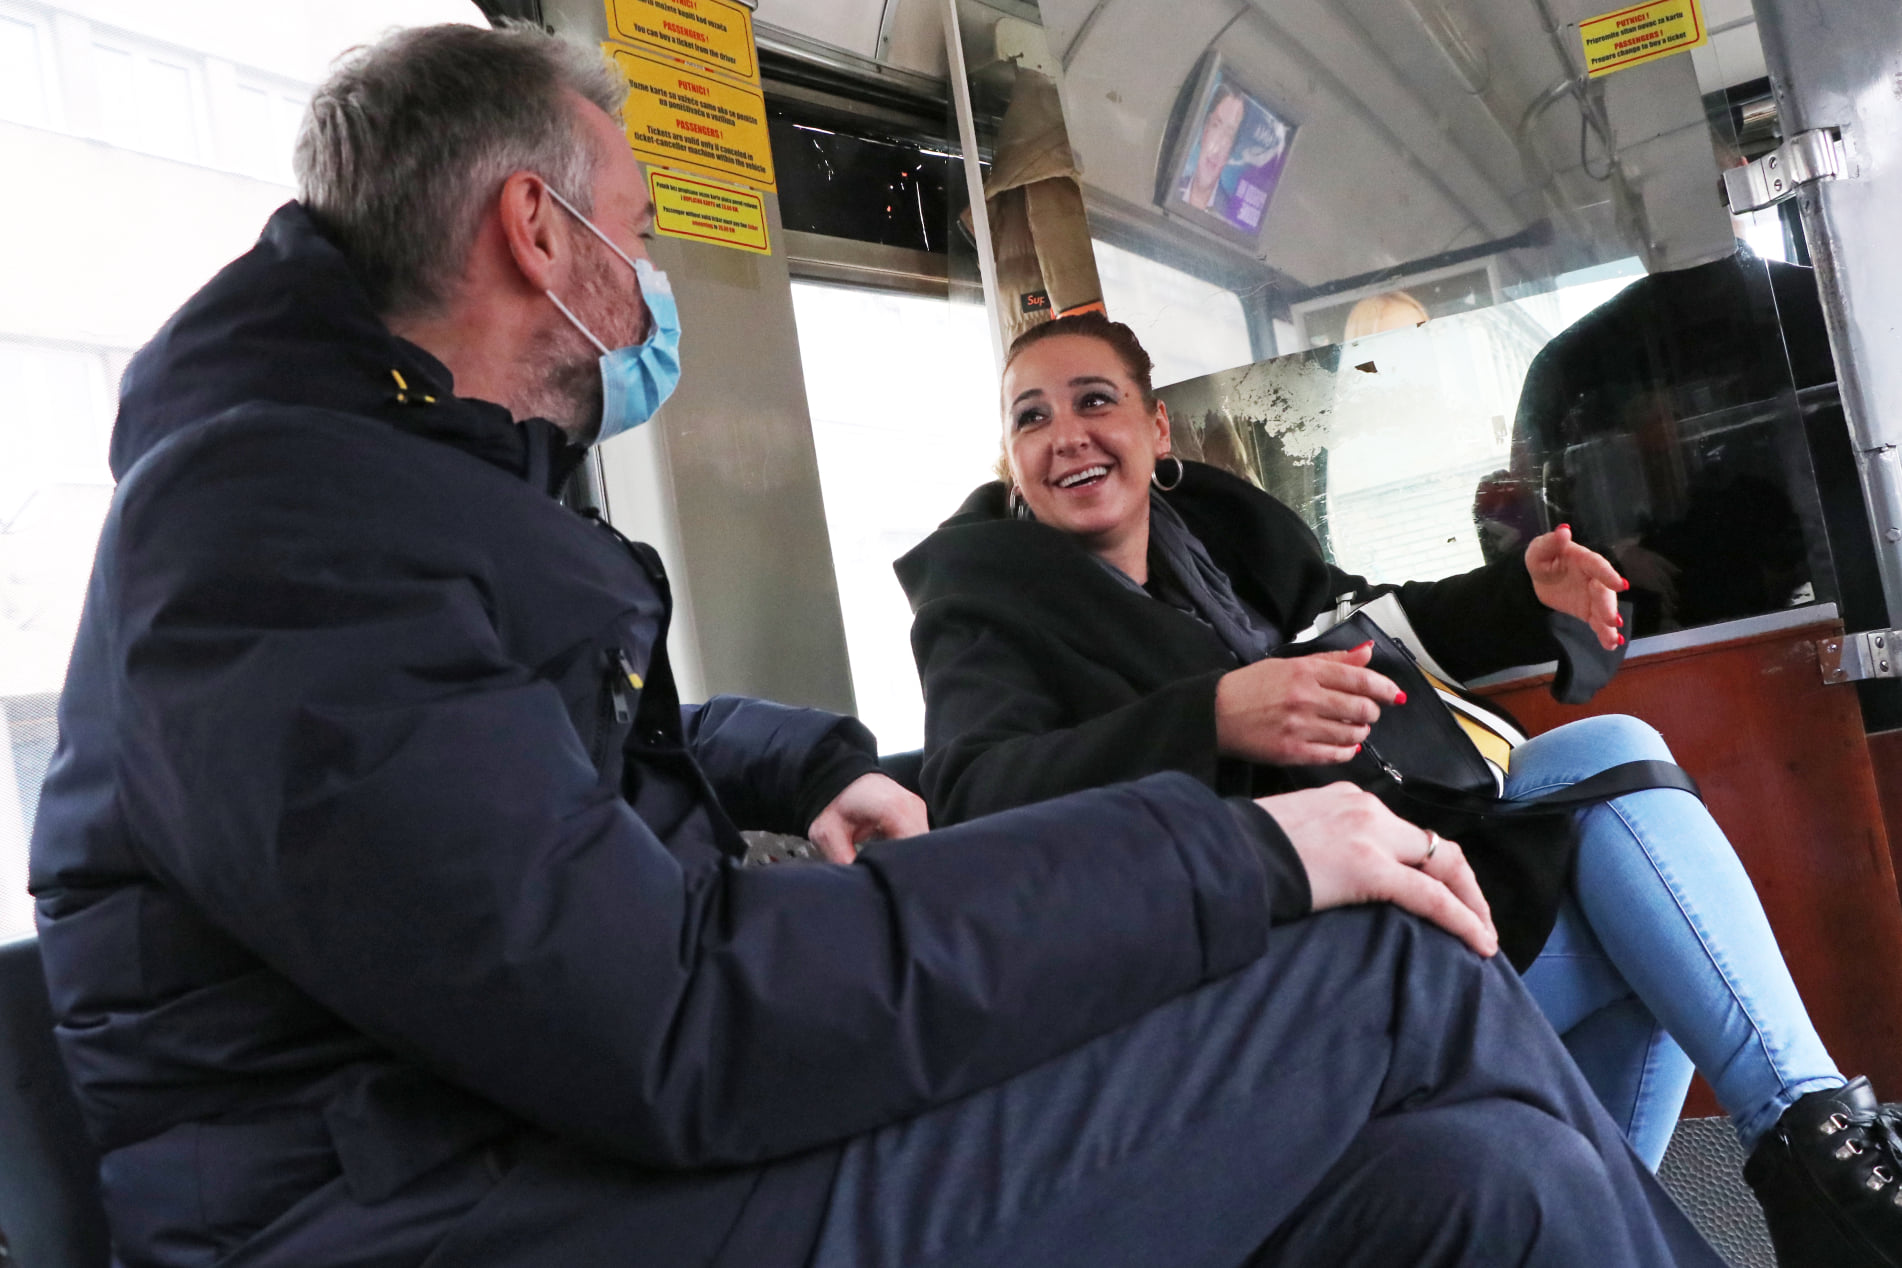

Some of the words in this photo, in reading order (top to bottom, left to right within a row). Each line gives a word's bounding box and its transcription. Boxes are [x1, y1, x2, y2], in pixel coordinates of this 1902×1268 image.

[663, 21, 705, 42] PASSENGERS
[1616, 14, 1646, 28] PUTNICI
[1638, 21, 1657, 30] novac
[1666, 12, 1684, 22] kartu
[634, 23, 646, 34] You
[647, 29, 658, 38] can
[660, 31, 670, 42] buy
[672, 36, 677, 44] a
[677, 37, 694, 49] ticket
[695, 44, 708, 55] from
[710, 48, 719, 58] the
[720, 52, 736, 64] driver
[1591, 53, 1616, 64] Prepare
[1617, 46, 1640, 58] change
[1649, 40, 1661, 49] buy
[1667, 31, 1686, 42] ticket
[1614, 31, 1659, 50] PASSENGERS
[678, 80, 706, 96] PUTNICI
[650, 84, 667, 97] karte
[700, 101, 716, 112] samo
[717, 104, 728, 115] ako
[647, 125, 672, 139] Tickets
[673, 132, 683, 142] are
[684, 135, 699, 146] valid
[701, 140, 714, 151] only
[676, 119, 719, 138] PASSENGERS
[688, 146, 715, 159] machine
[716, 152, 734, 164] within
[735, 157, 745, 166] the
[746, 160, 766, 173] vehicle
